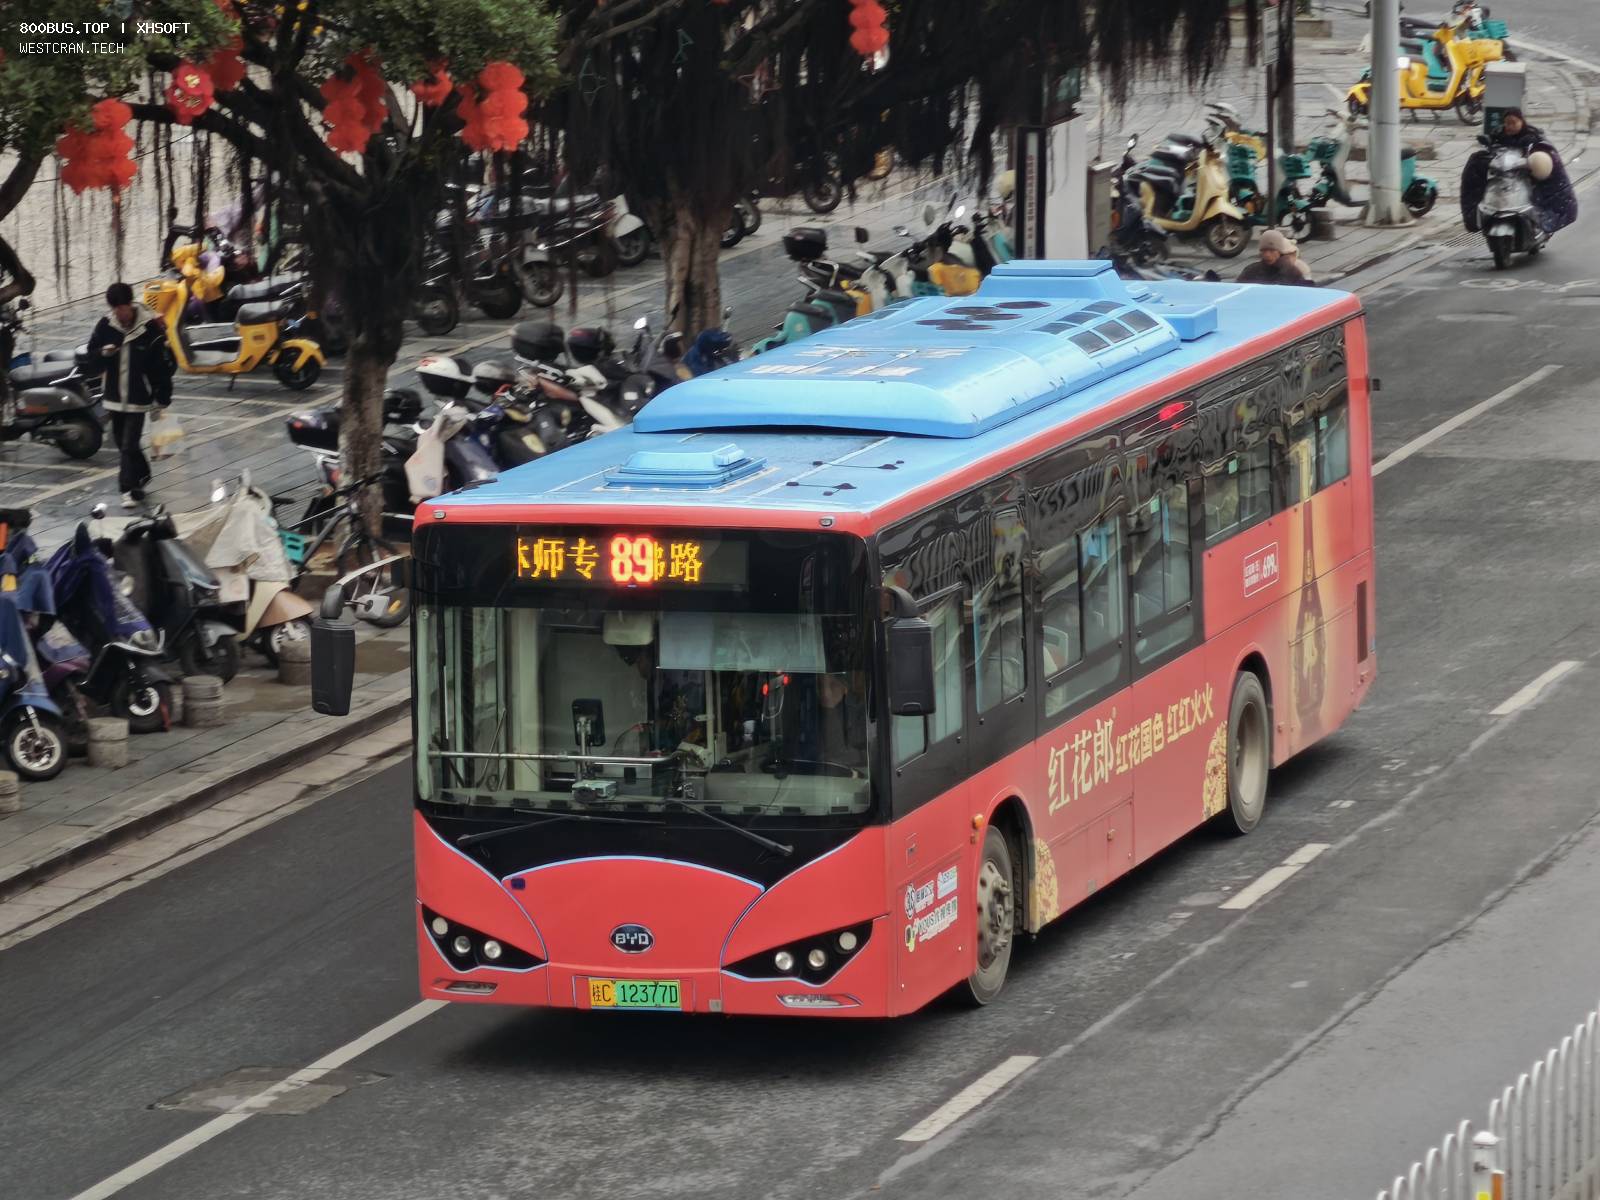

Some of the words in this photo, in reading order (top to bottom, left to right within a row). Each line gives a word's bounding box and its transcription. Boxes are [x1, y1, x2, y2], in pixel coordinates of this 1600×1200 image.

[610, 535, 654, 583] 89
[1048, 717, 1114, 817] 红花郎
[1167, 682, 1214, 744] 红红火火
[615, 932, 650, 945] BYD
